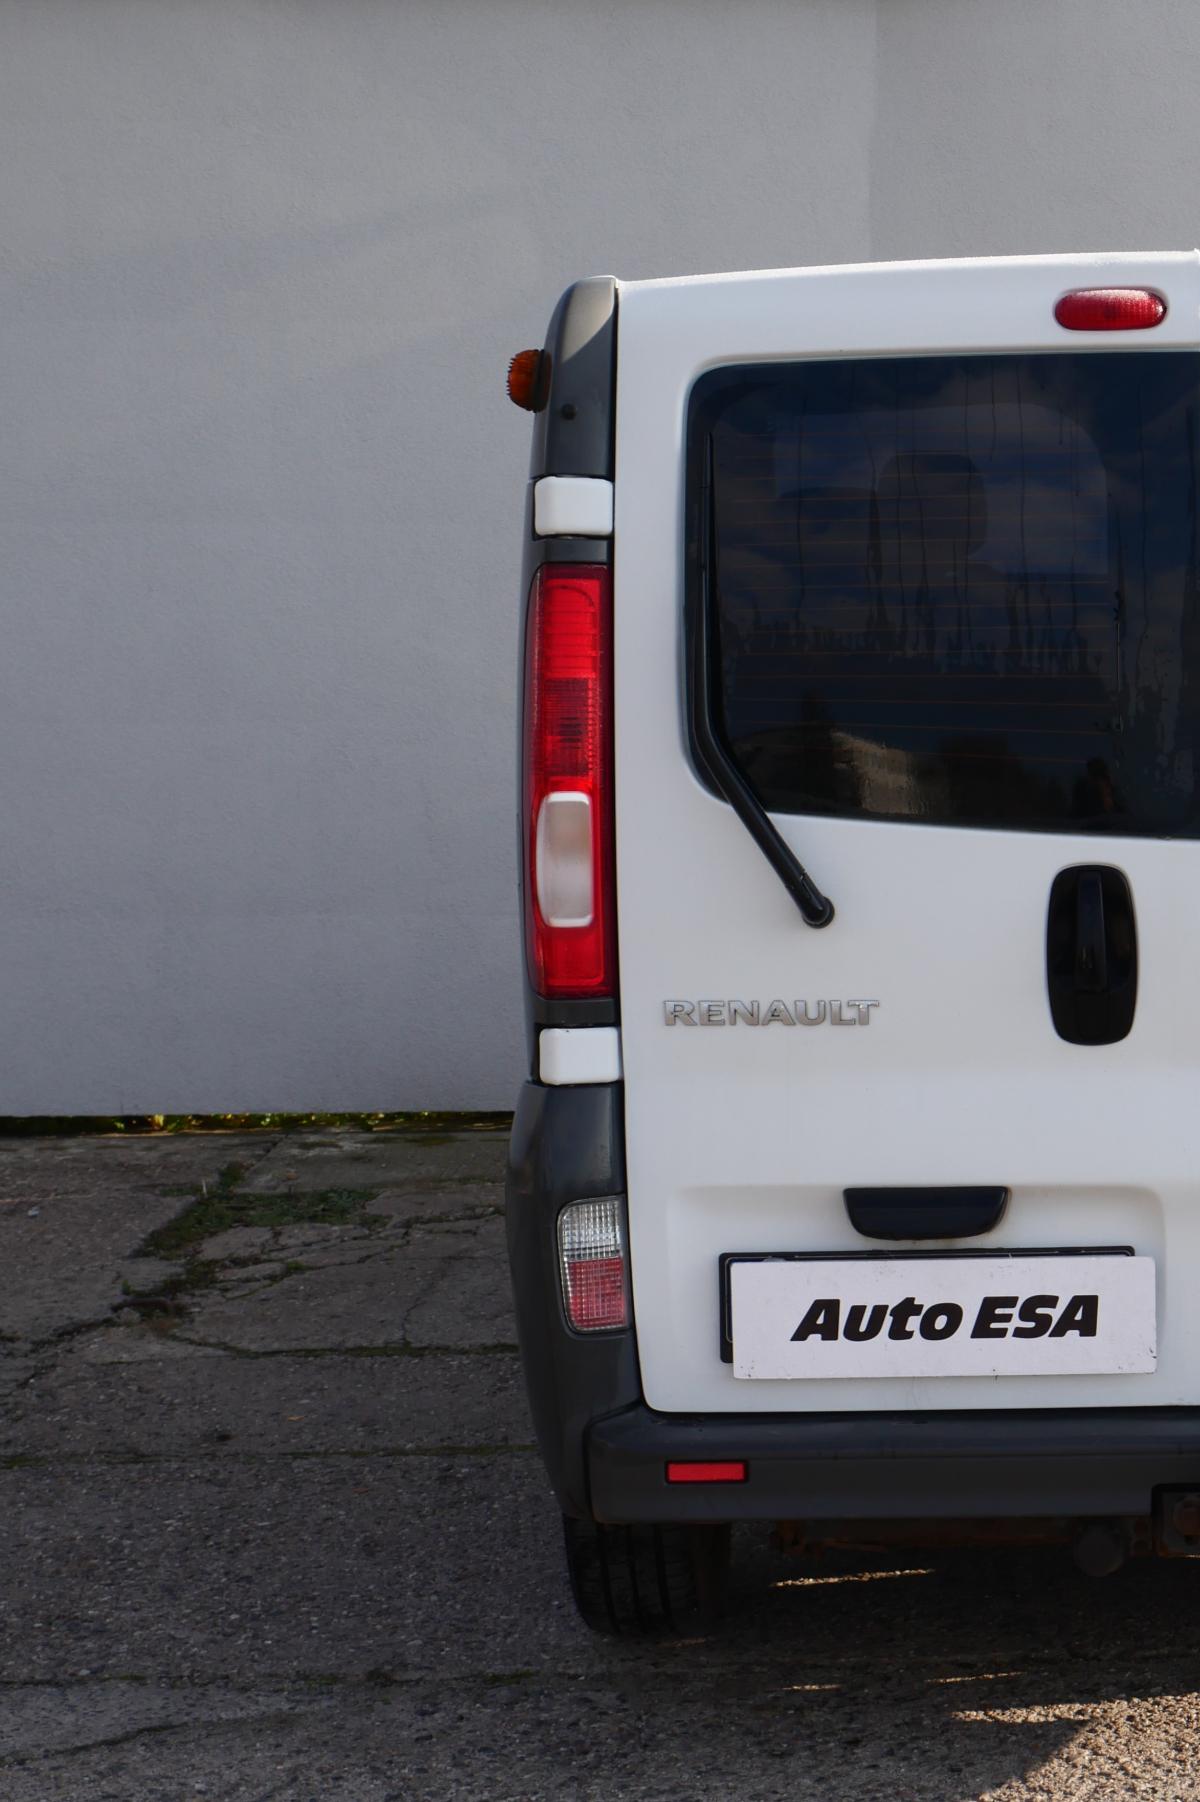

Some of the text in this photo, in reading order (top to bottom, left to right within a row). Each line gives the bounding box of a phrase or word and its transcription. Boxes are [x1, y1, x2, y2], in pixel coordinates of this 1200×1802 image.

[663, 1000, 880, 1026] RENAULT
[790, 1294, 1099, 1342] Auto ESA
